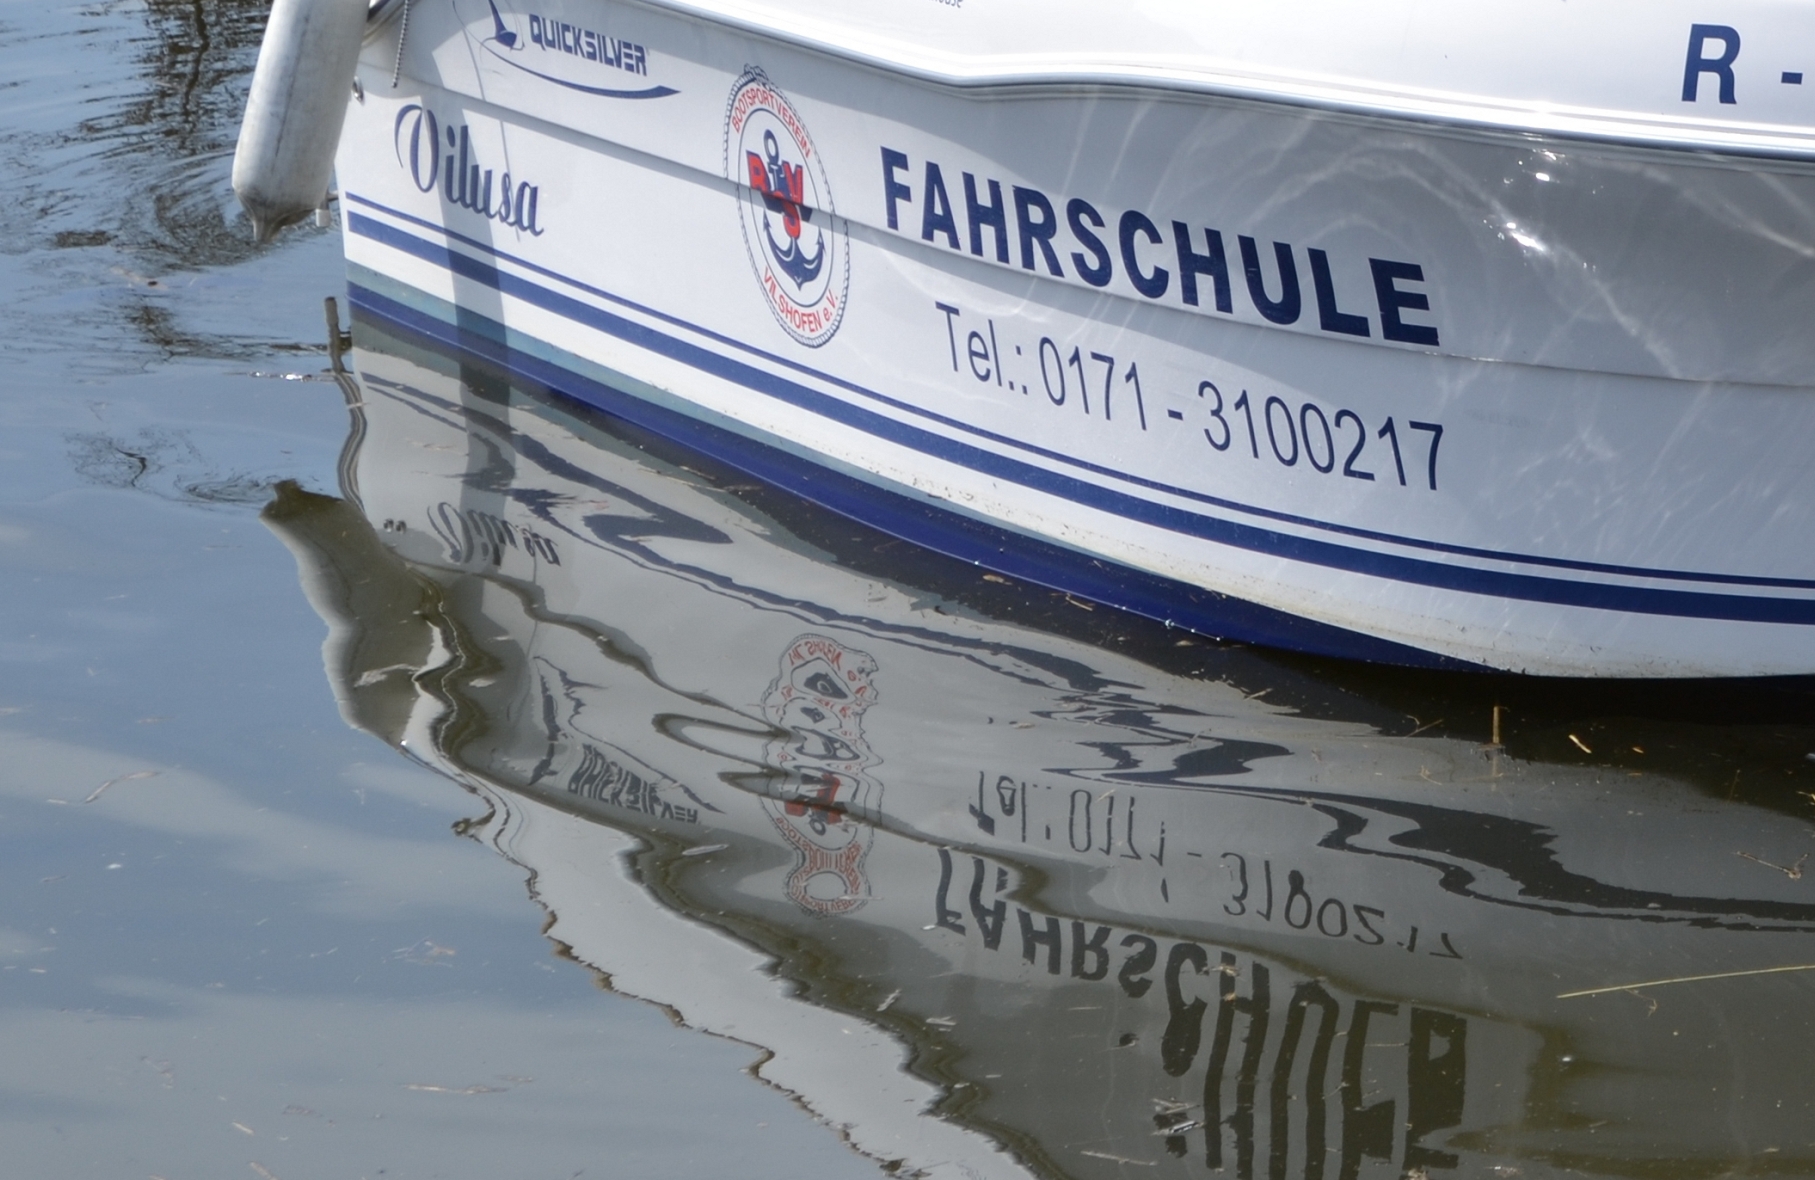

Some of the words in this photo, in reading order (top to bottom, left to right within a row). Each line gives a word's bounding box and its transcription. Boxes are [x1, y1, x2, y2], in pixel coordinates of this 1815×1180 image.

[528, 13, 648, 76] QUICKSILVER
[1681, 23, 1741, 105] R
[1781, 71, 1803, 86] -
[731, 87, 811, 159] BOOTSPORTVEREIN
[394, 104, 544, 237] Vilusa
[880, 145, 1440, 347] FAHRSCHULE
[763, 266, 823, 333] VILSHOFEN
[935, 301, 1028, 395] Tel.:
[1039, 337, 1147, 431] 0171
[1198, 381, 1444, 491] 3100217
